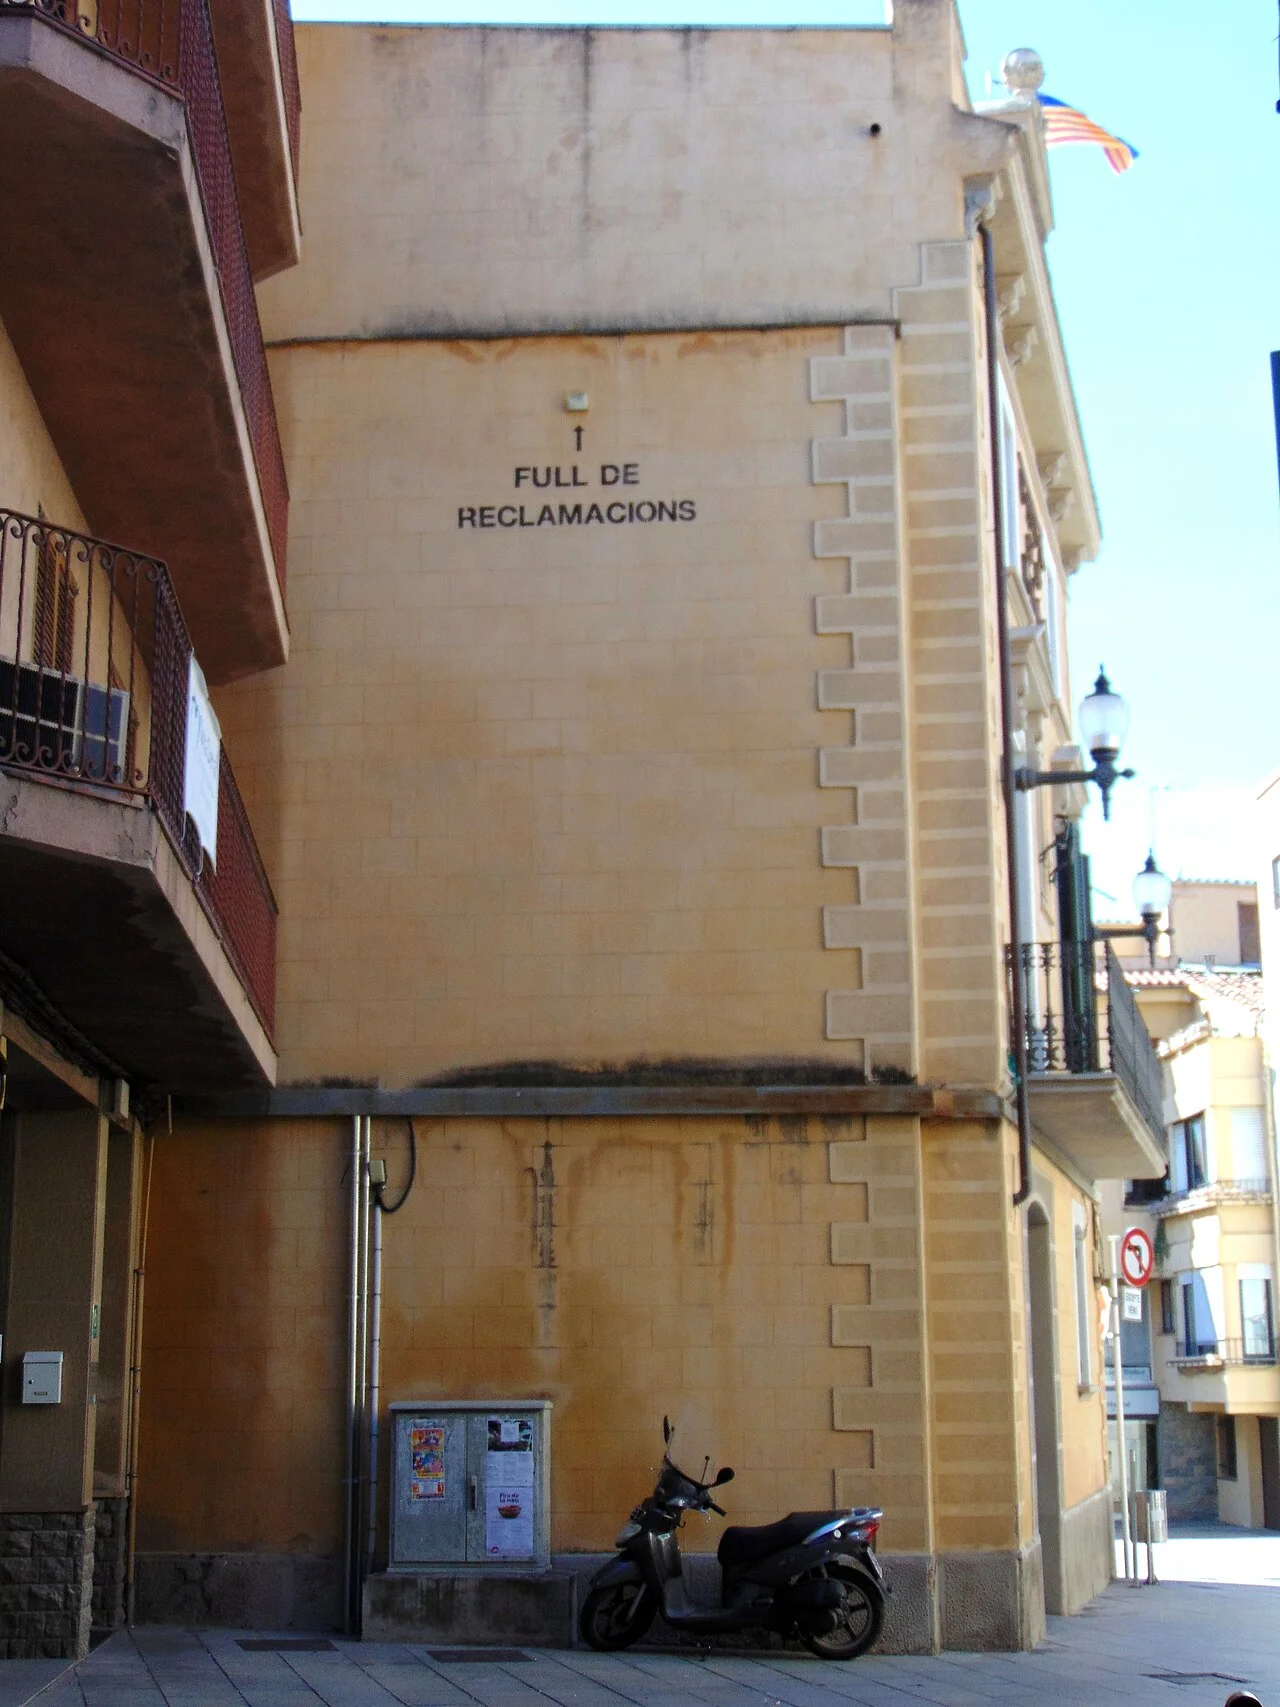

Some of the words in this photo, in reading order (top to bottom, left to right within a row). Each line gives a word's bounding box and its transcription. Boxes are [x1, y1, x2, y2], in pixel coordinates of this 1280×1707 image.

[514, 465, 588, 488] FULL
[601, 463, 640, 485] DE
[458, 500, 697, 528] RECLAMACIONS
